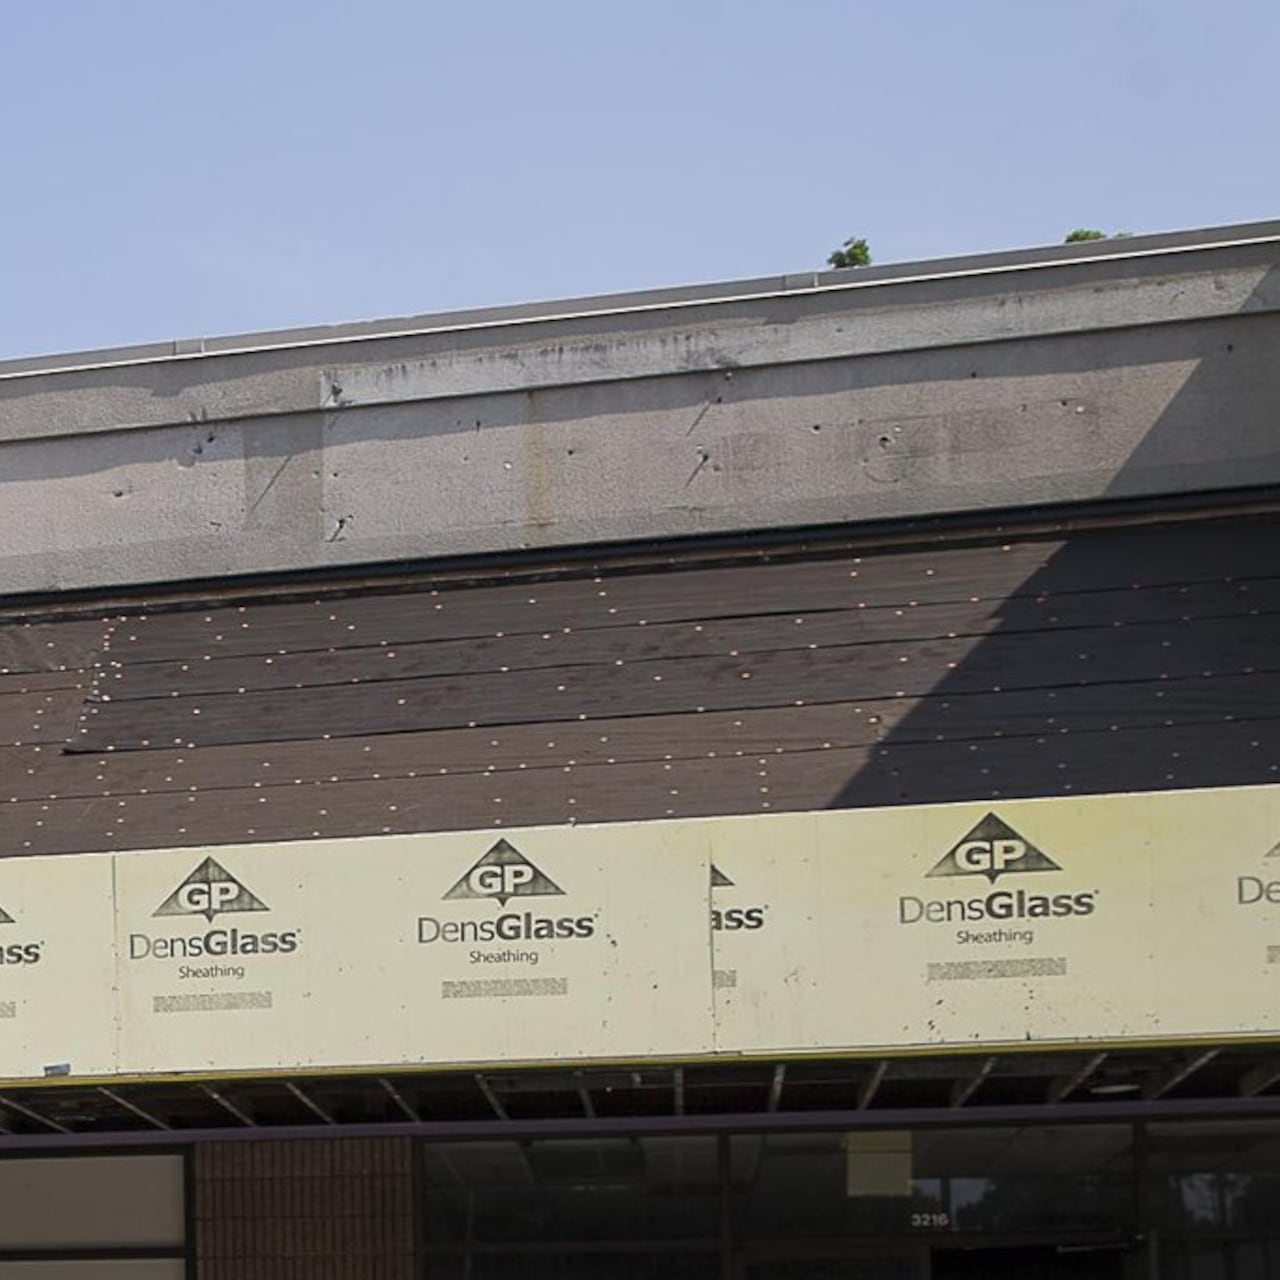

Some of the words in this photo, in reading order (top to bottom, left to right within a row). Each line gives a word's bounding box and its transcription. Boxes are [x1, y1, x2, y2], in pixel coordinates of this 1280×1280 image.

[954, 839, 1027, 872] GP
[469, 864, 534, 894] GP
[177, 881, 240, 913] GP
[899, 889, 1096, 925] DensGlass
[417, 911, 595, 944] DensGlass
[956, 928, 1034, 946] Sheathing
[129, 928, 298, 960] DensGlass
[469, 948, 539, 965] Sheathing
[178, 964, 245, 980] Sheathing
